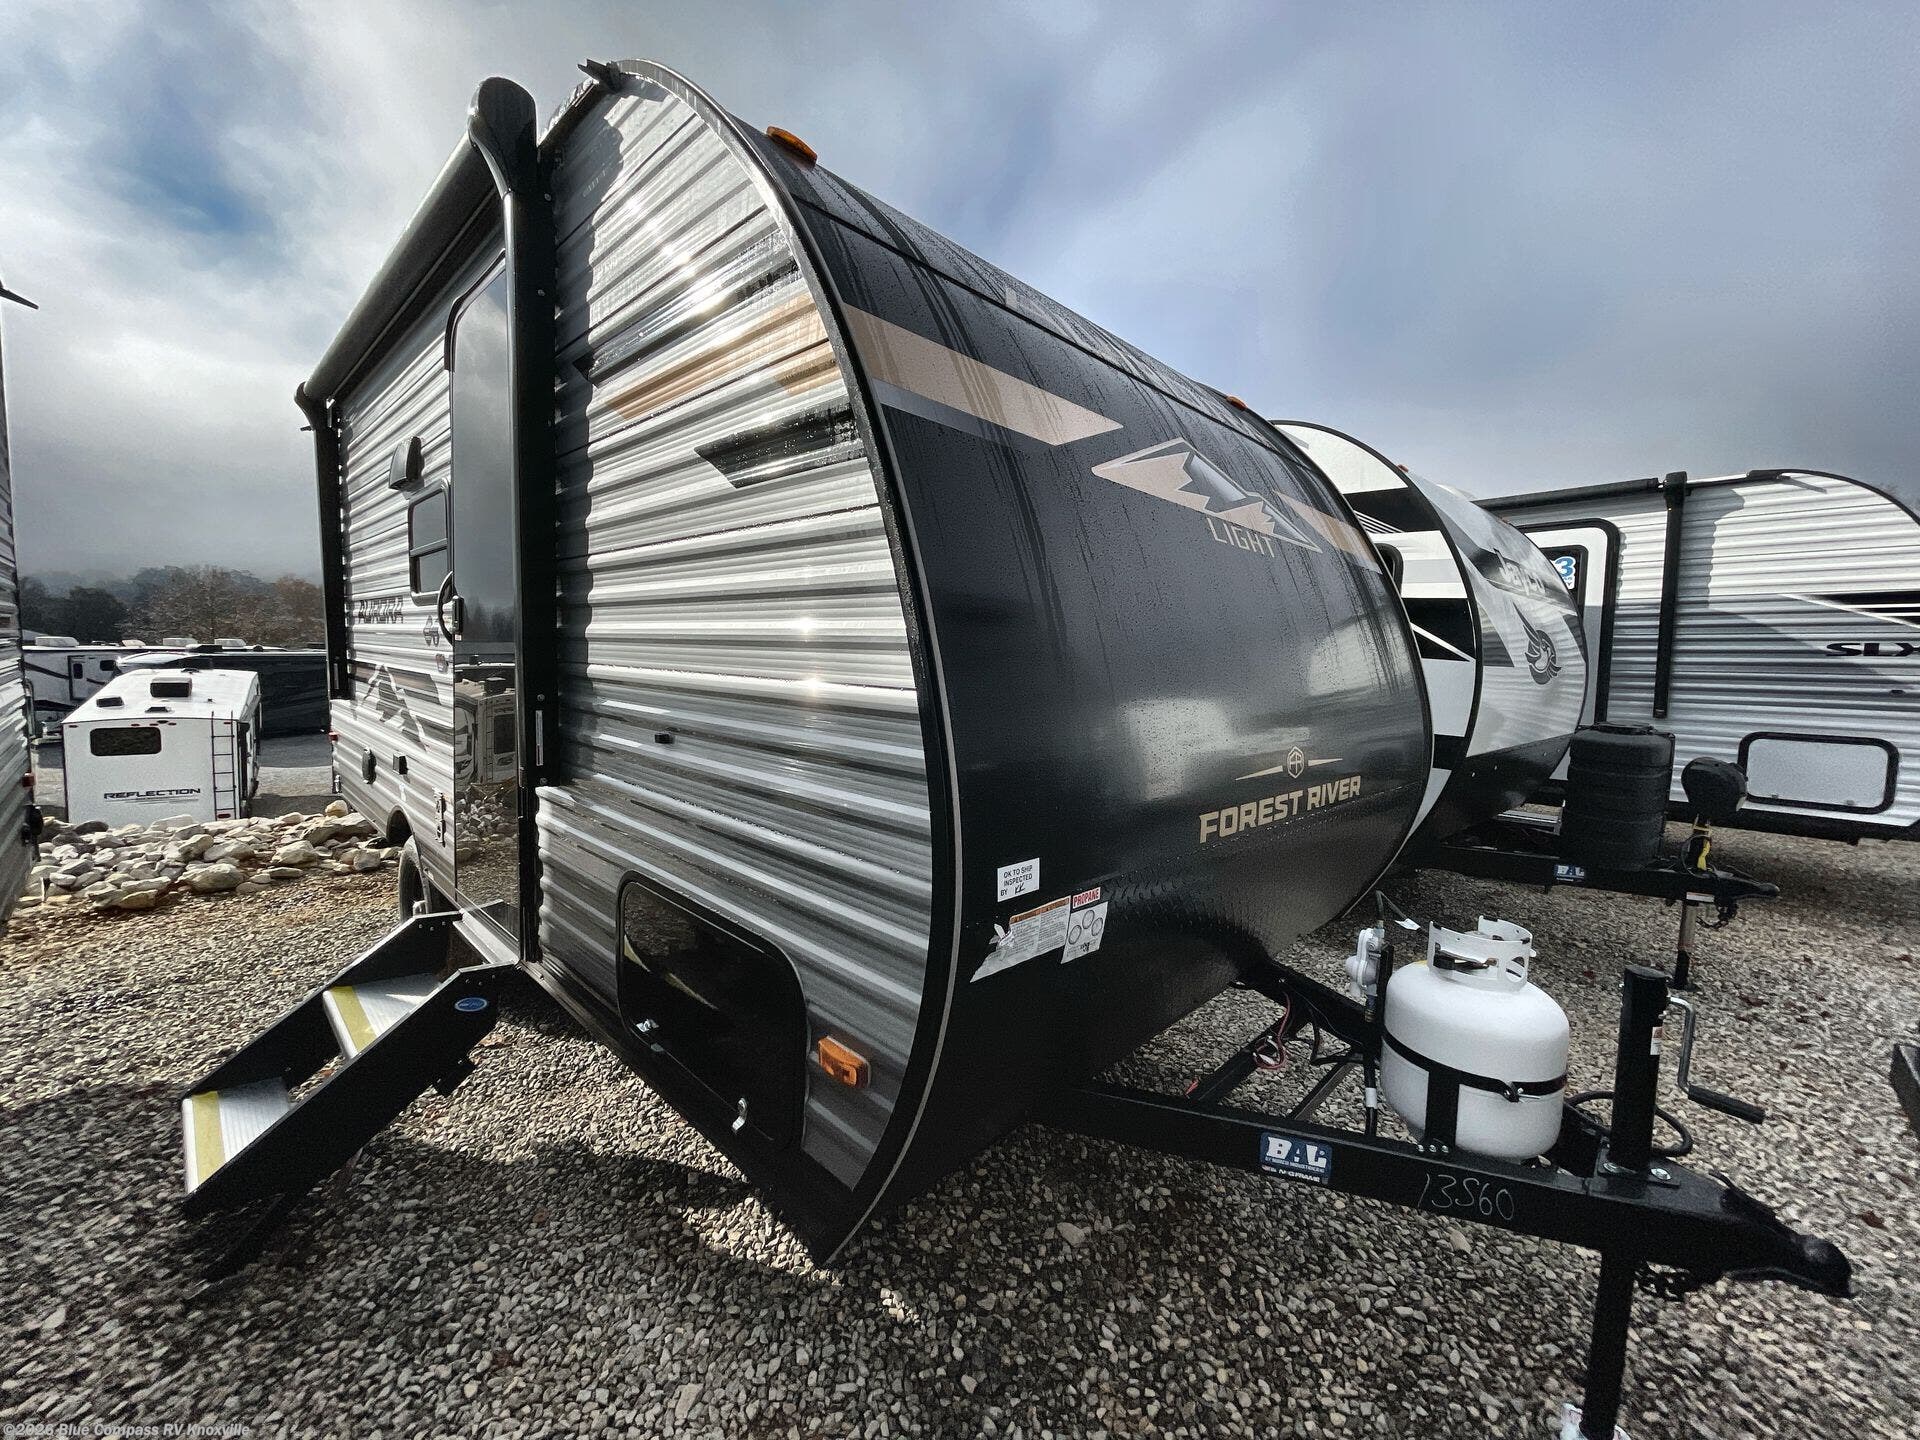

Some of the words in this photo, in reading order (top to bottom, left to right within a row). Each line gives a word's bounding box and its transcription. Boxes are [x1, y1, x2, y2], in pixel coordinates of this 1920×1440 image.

[1206, 517, 1275, 558] LIGHT
[103, 788, 201, 800] REFLECTION
[1199, 790, 1303, 844] FOREST
[1307, 775, 1362, 811] RIVER
[1003, 871, 1012, 879] OK
[1013, 868, 1020, 876] TO
[1003, 873, 1033, 887] INSPECTED
[1000, 889, 1008, 897] BY
[1073, 889, 1100, 907] PROPANE
[1266, 1136, 1327, 1169] BAL
